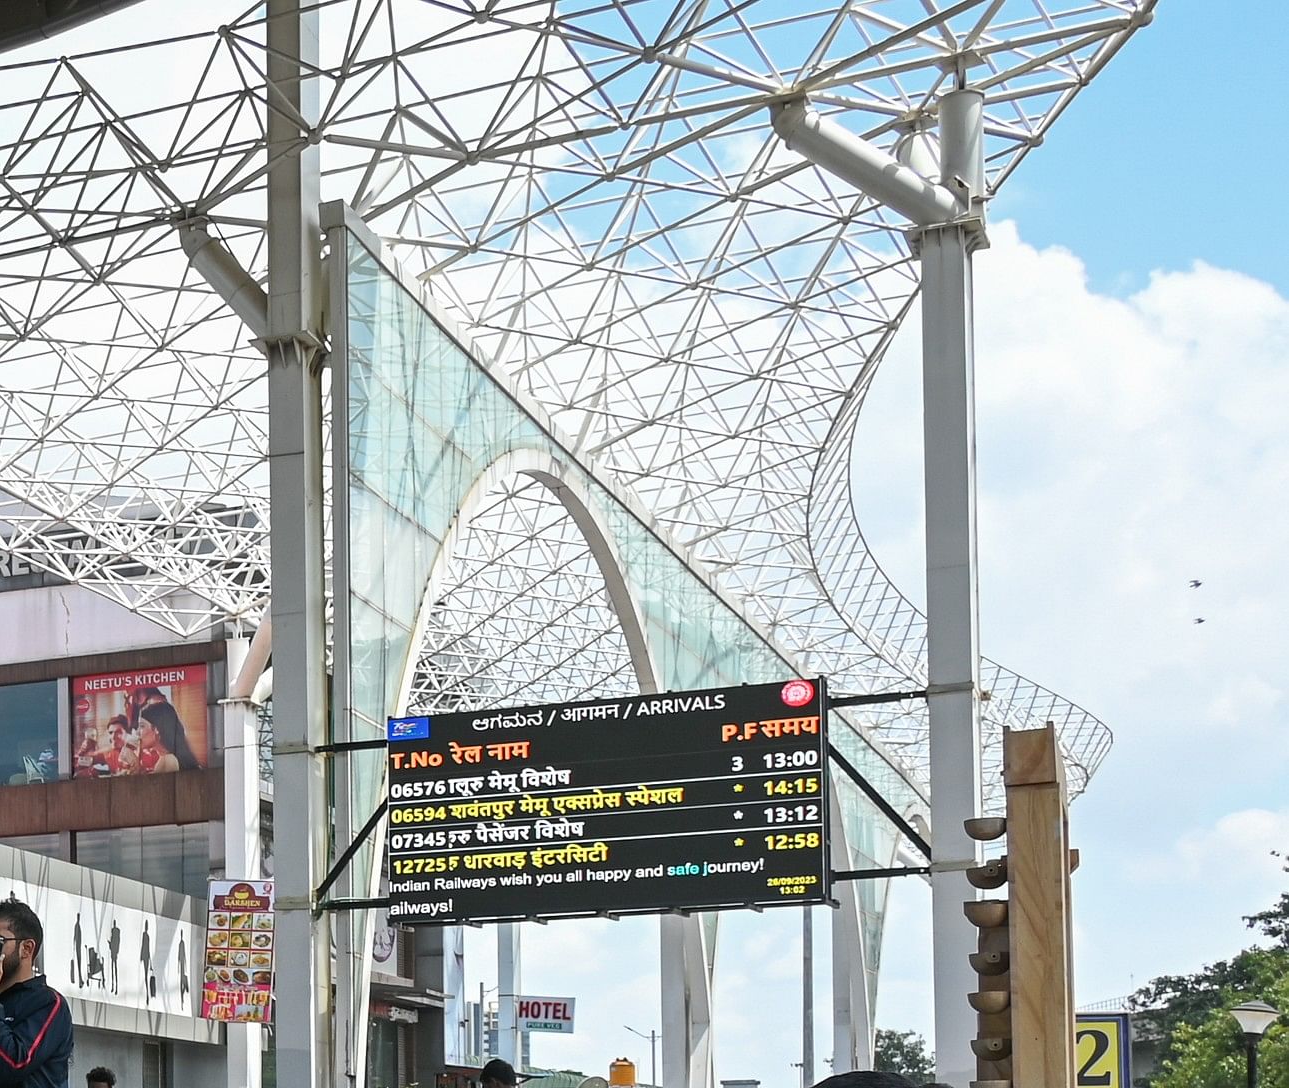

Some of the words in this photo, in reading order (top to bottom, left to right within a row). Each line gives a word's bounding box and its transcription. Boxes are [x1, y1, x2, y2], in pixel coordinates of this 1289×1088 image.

[84, 676, 133, 691] NEETU'S
[134, 670, 186, 686] KITCHEN
[560, 704, 620, 722] आगमन
[636, 694, 725, 717] ARRIVALS
[472, 710, 543, 731] ಆಗಮನ
[759, 716, 819, 739] समय
[721, 722, 758, 742] P.F
[390, 751, 443, 770] T.No
[448, 741, 483, 764] रेल
[487, 740, 531, 761] नाम
[731, 756, 744, 772] 3
[763, 750, 818, 769] 13:00
[390, 780, 446, 799] 06576
[487, 771, 521, 793] मेमू
[520, 766, 572, 787] विशेष
[763, 778, 819, 796] 14:15
[391, 806, 447, 824] 06594
[520, 795, 550, 817] मेमू
[551, 789, 621, 814] एक्सप्रेस
[625, 785, 685, 807] स्पेशल
[763, 804, 819, 823] 13:12
[391, 831, 446, 849] 07345
[474, 820, 532, 844] पैसेंजर
[534, 818, 585, 840] विशेष
[764, 832, 819, 850] 12:58
[393, 856, 447, 875] 12725
[463, 850, 527, 870] धारवाड़
[530, 842, 608, 866] इंटरसिटी
[389, 879, 431, 894] Indian
[434, 874, 497, 892] Railways
[499, 871, 532, 887] wish
[535, 872, 562, 888] you
[565, 869, 583, 882] all
[586, 866, 632, 885] happy
[635, 863, 664, 878] and
[667, 862, 700, 877] safe
[702, 857, 765, 877] journey!
[389, 898, 454, 917] ailways!
[519, 1000, 571, 1021] HOTEL
[1076, 1029, 1112, 1087] 2
